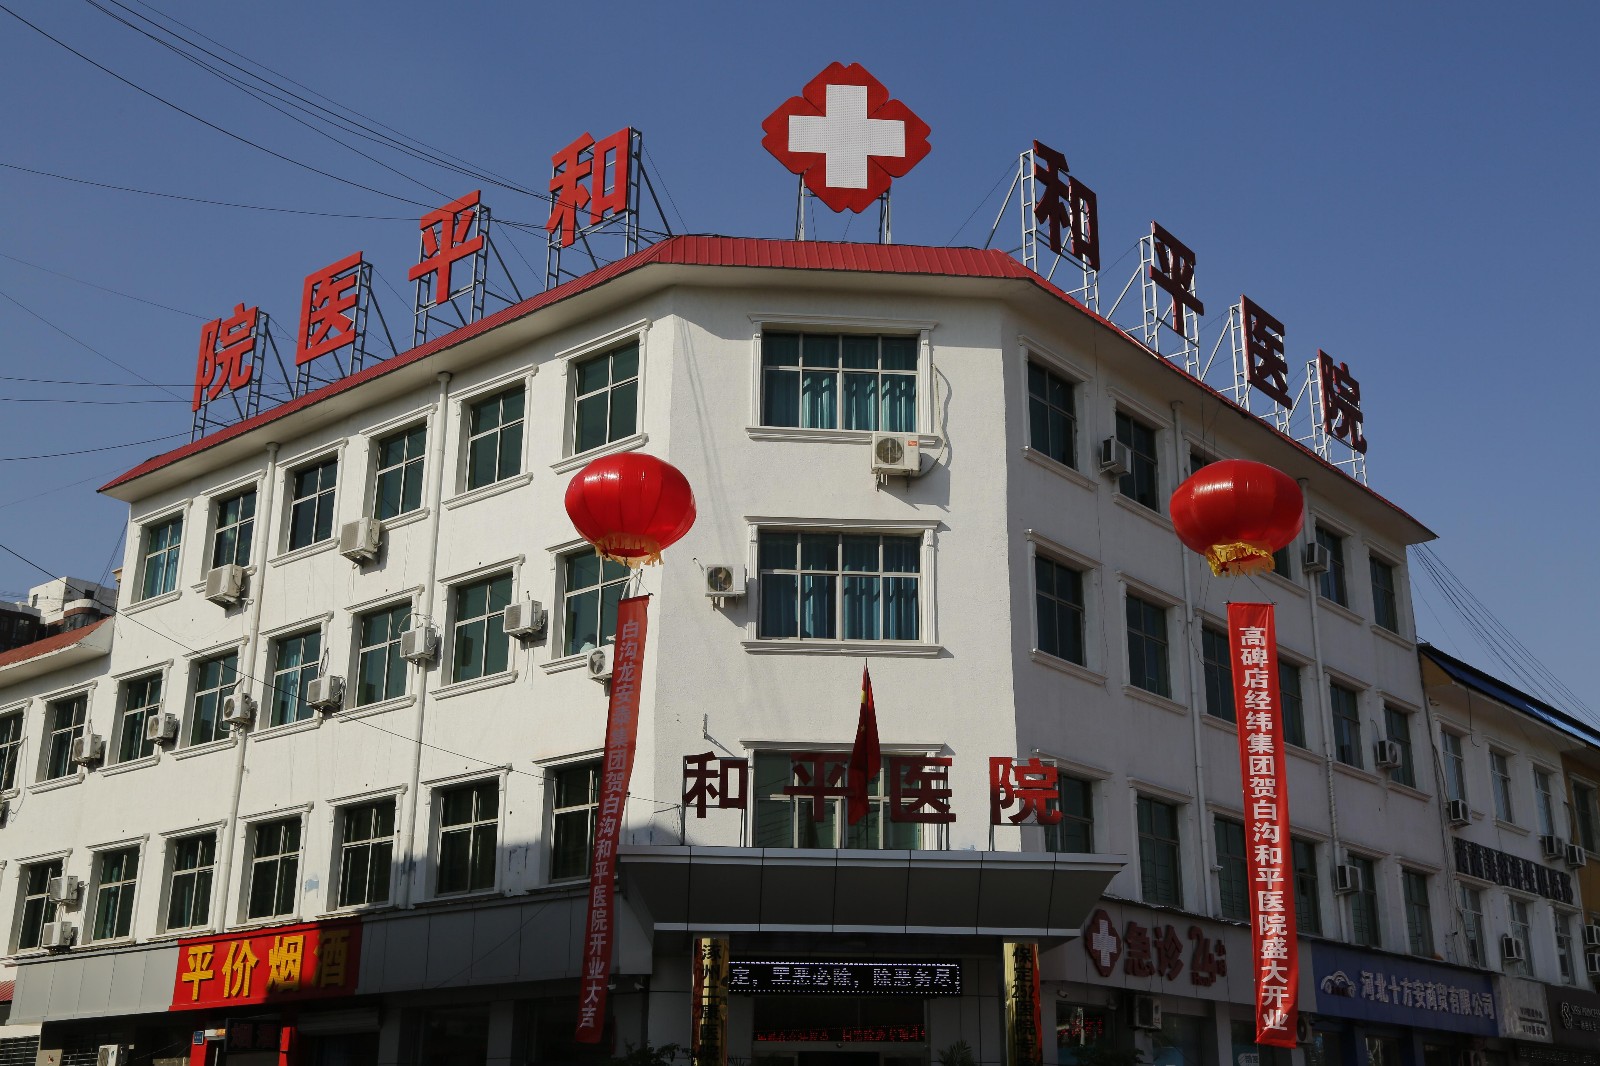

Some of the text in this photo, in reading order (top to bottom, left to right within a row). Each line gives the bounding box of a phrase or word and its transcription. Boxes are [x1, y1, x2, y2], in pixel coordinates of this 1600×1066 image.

[1033, 139, 1367, 454] 和平医院
[683, 751, 1063, 826] 和平医院
[1238, 626, 1290, 1031] 高碑店经纬集团贺白沟和平医院盛大开业
[182, 929, 350, 1000] 平价烟酒
[1360, 970, 1495, 1020] 河北十方安商贸有限公司
